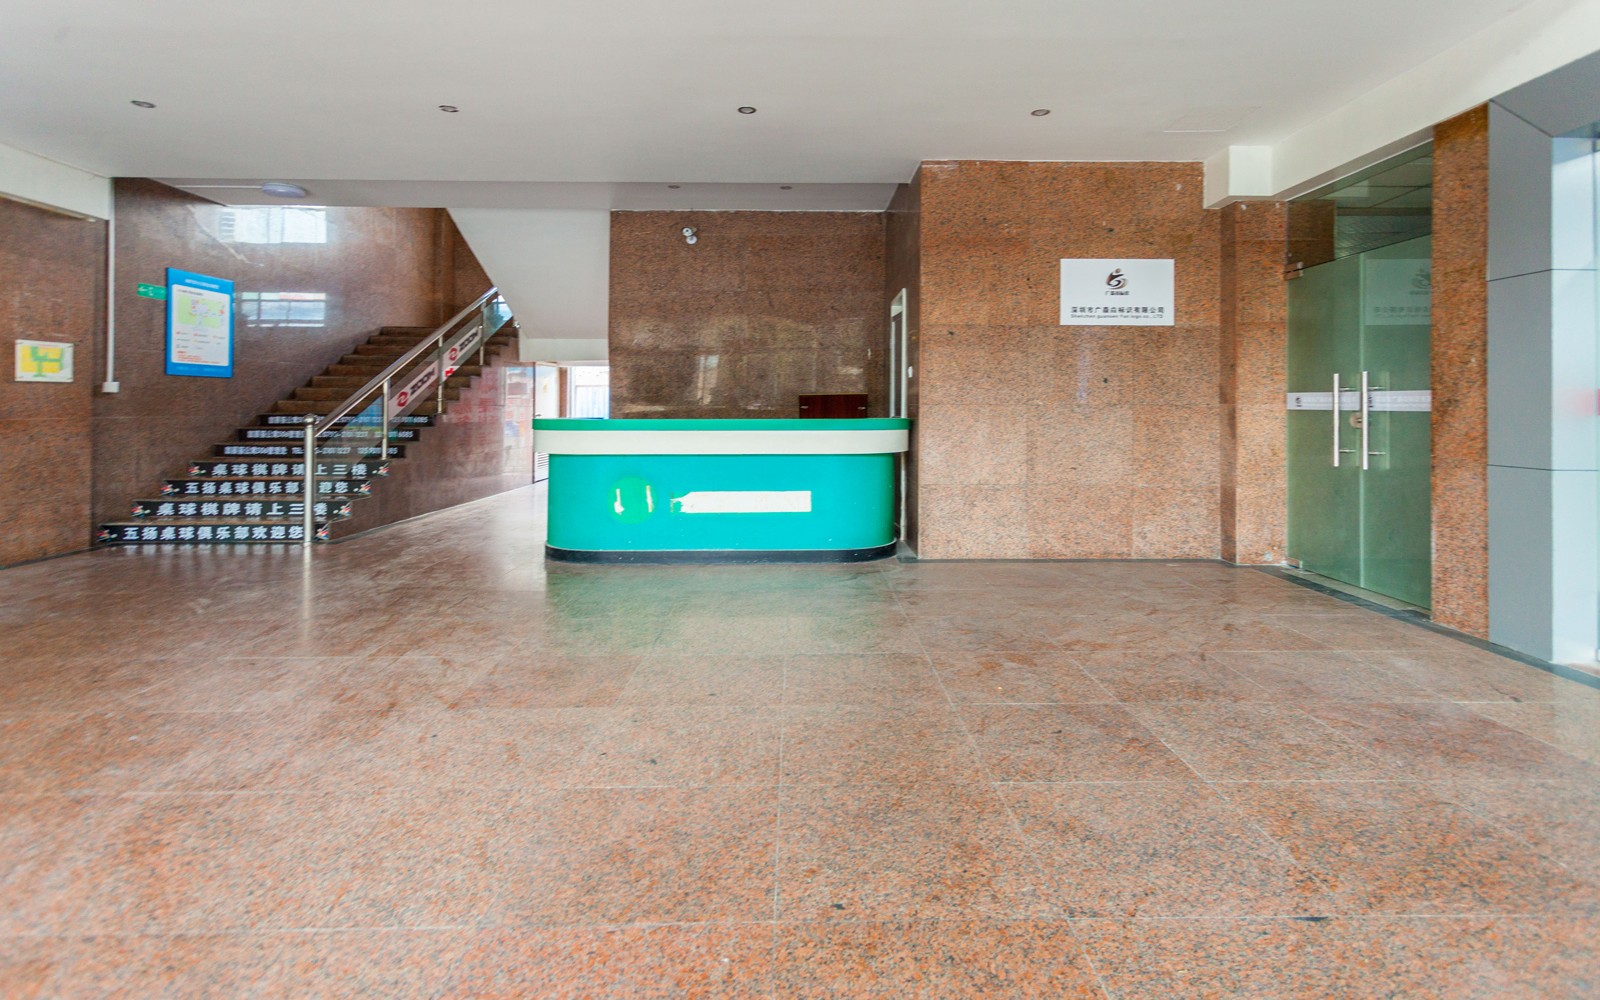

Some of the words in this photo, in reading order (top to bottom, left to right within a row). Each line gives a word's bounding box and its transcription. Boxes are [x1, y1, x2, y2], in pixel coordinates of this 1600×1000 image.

[184, 481, 348, 494] 五扬桌球俱乐部迎您
